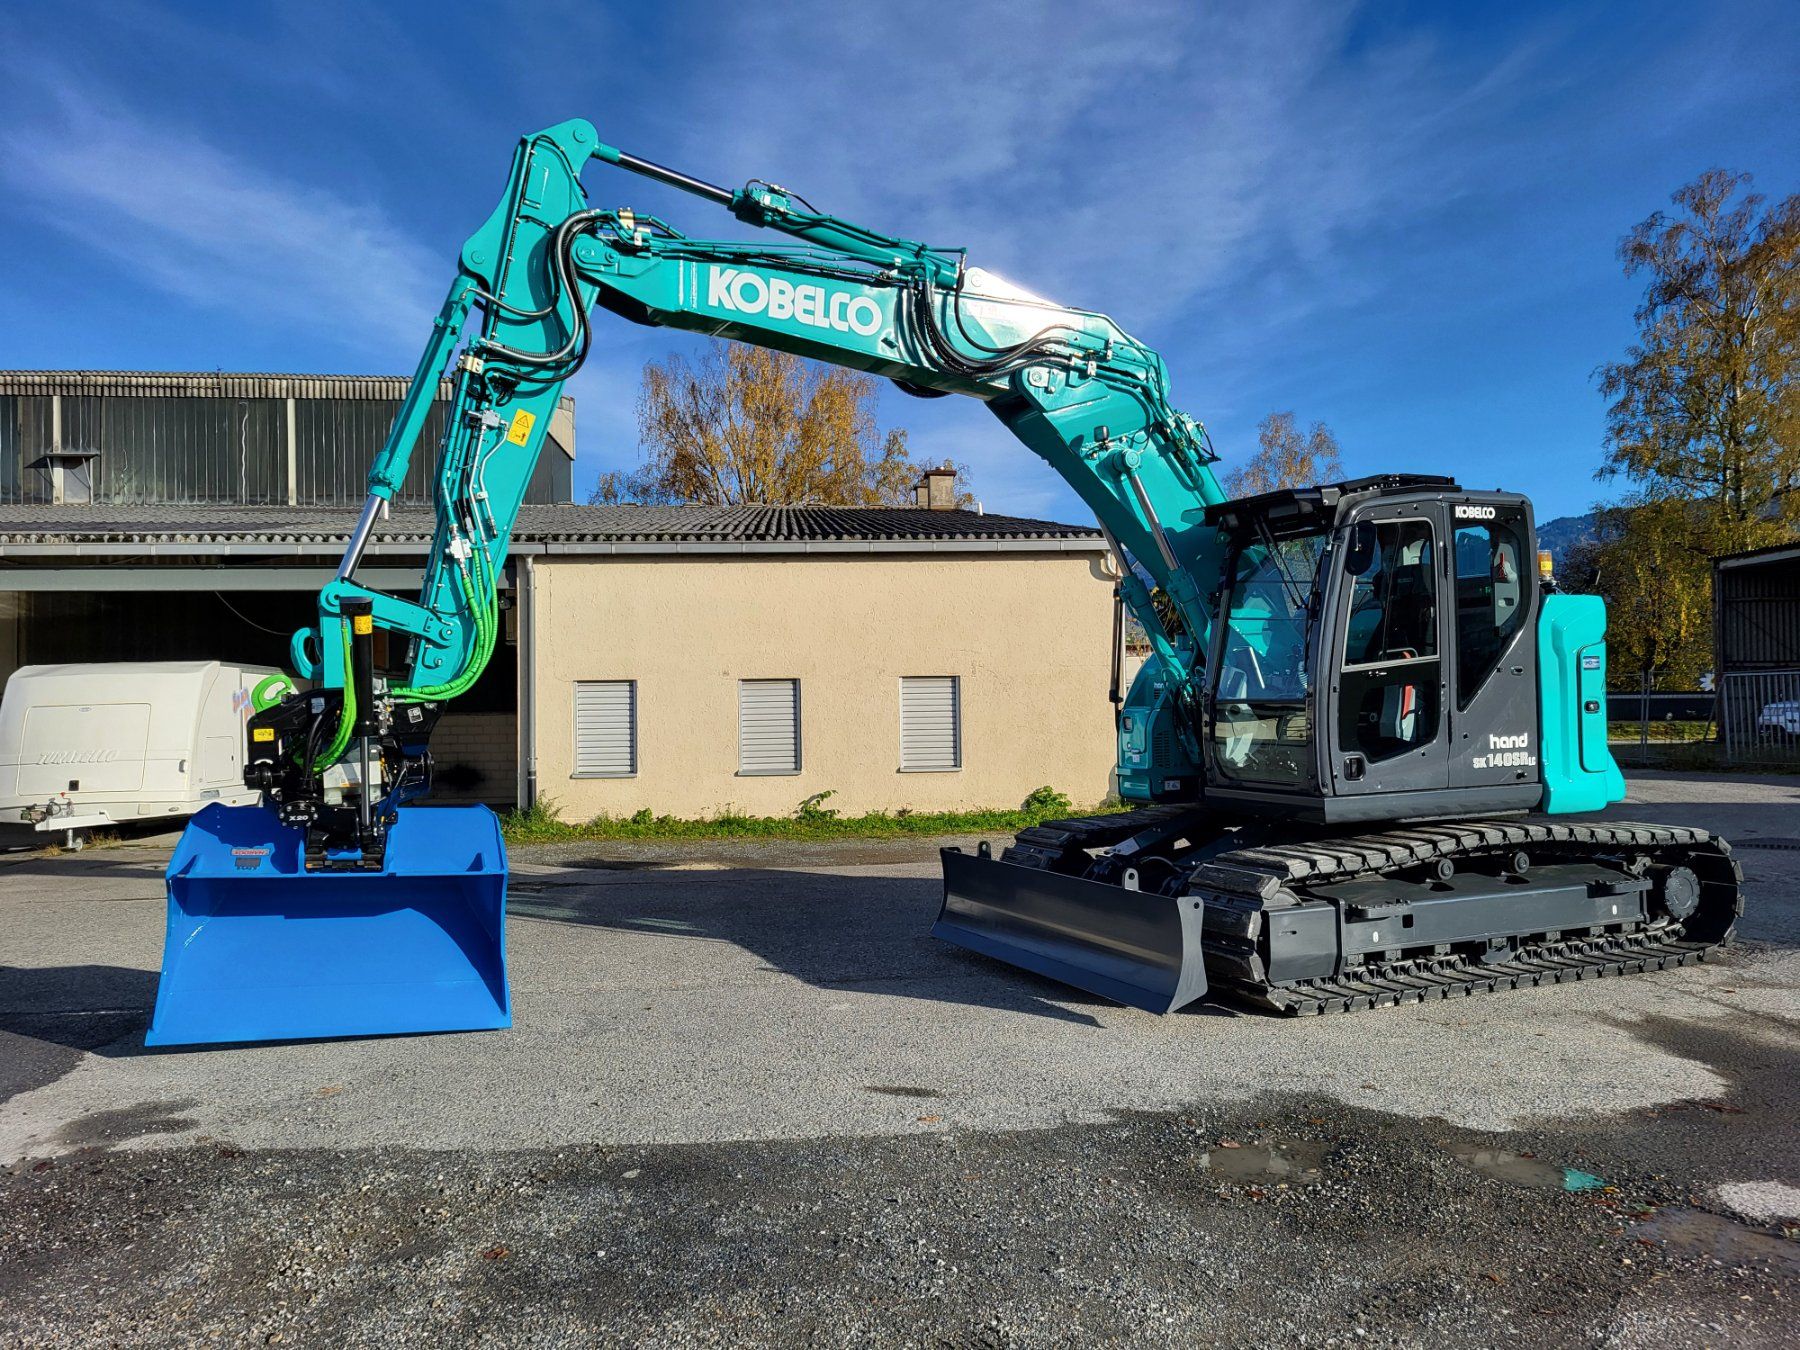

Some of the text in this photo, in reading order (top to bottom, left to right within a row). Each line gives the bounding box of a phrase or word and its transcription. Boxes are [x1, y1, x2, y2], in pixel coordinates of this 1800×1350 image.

[708, 265, 883, 336] KOBELCO
[1454, 505, 1496, 519] KOBELCO
[1489, 732, 1528, 750] hand
